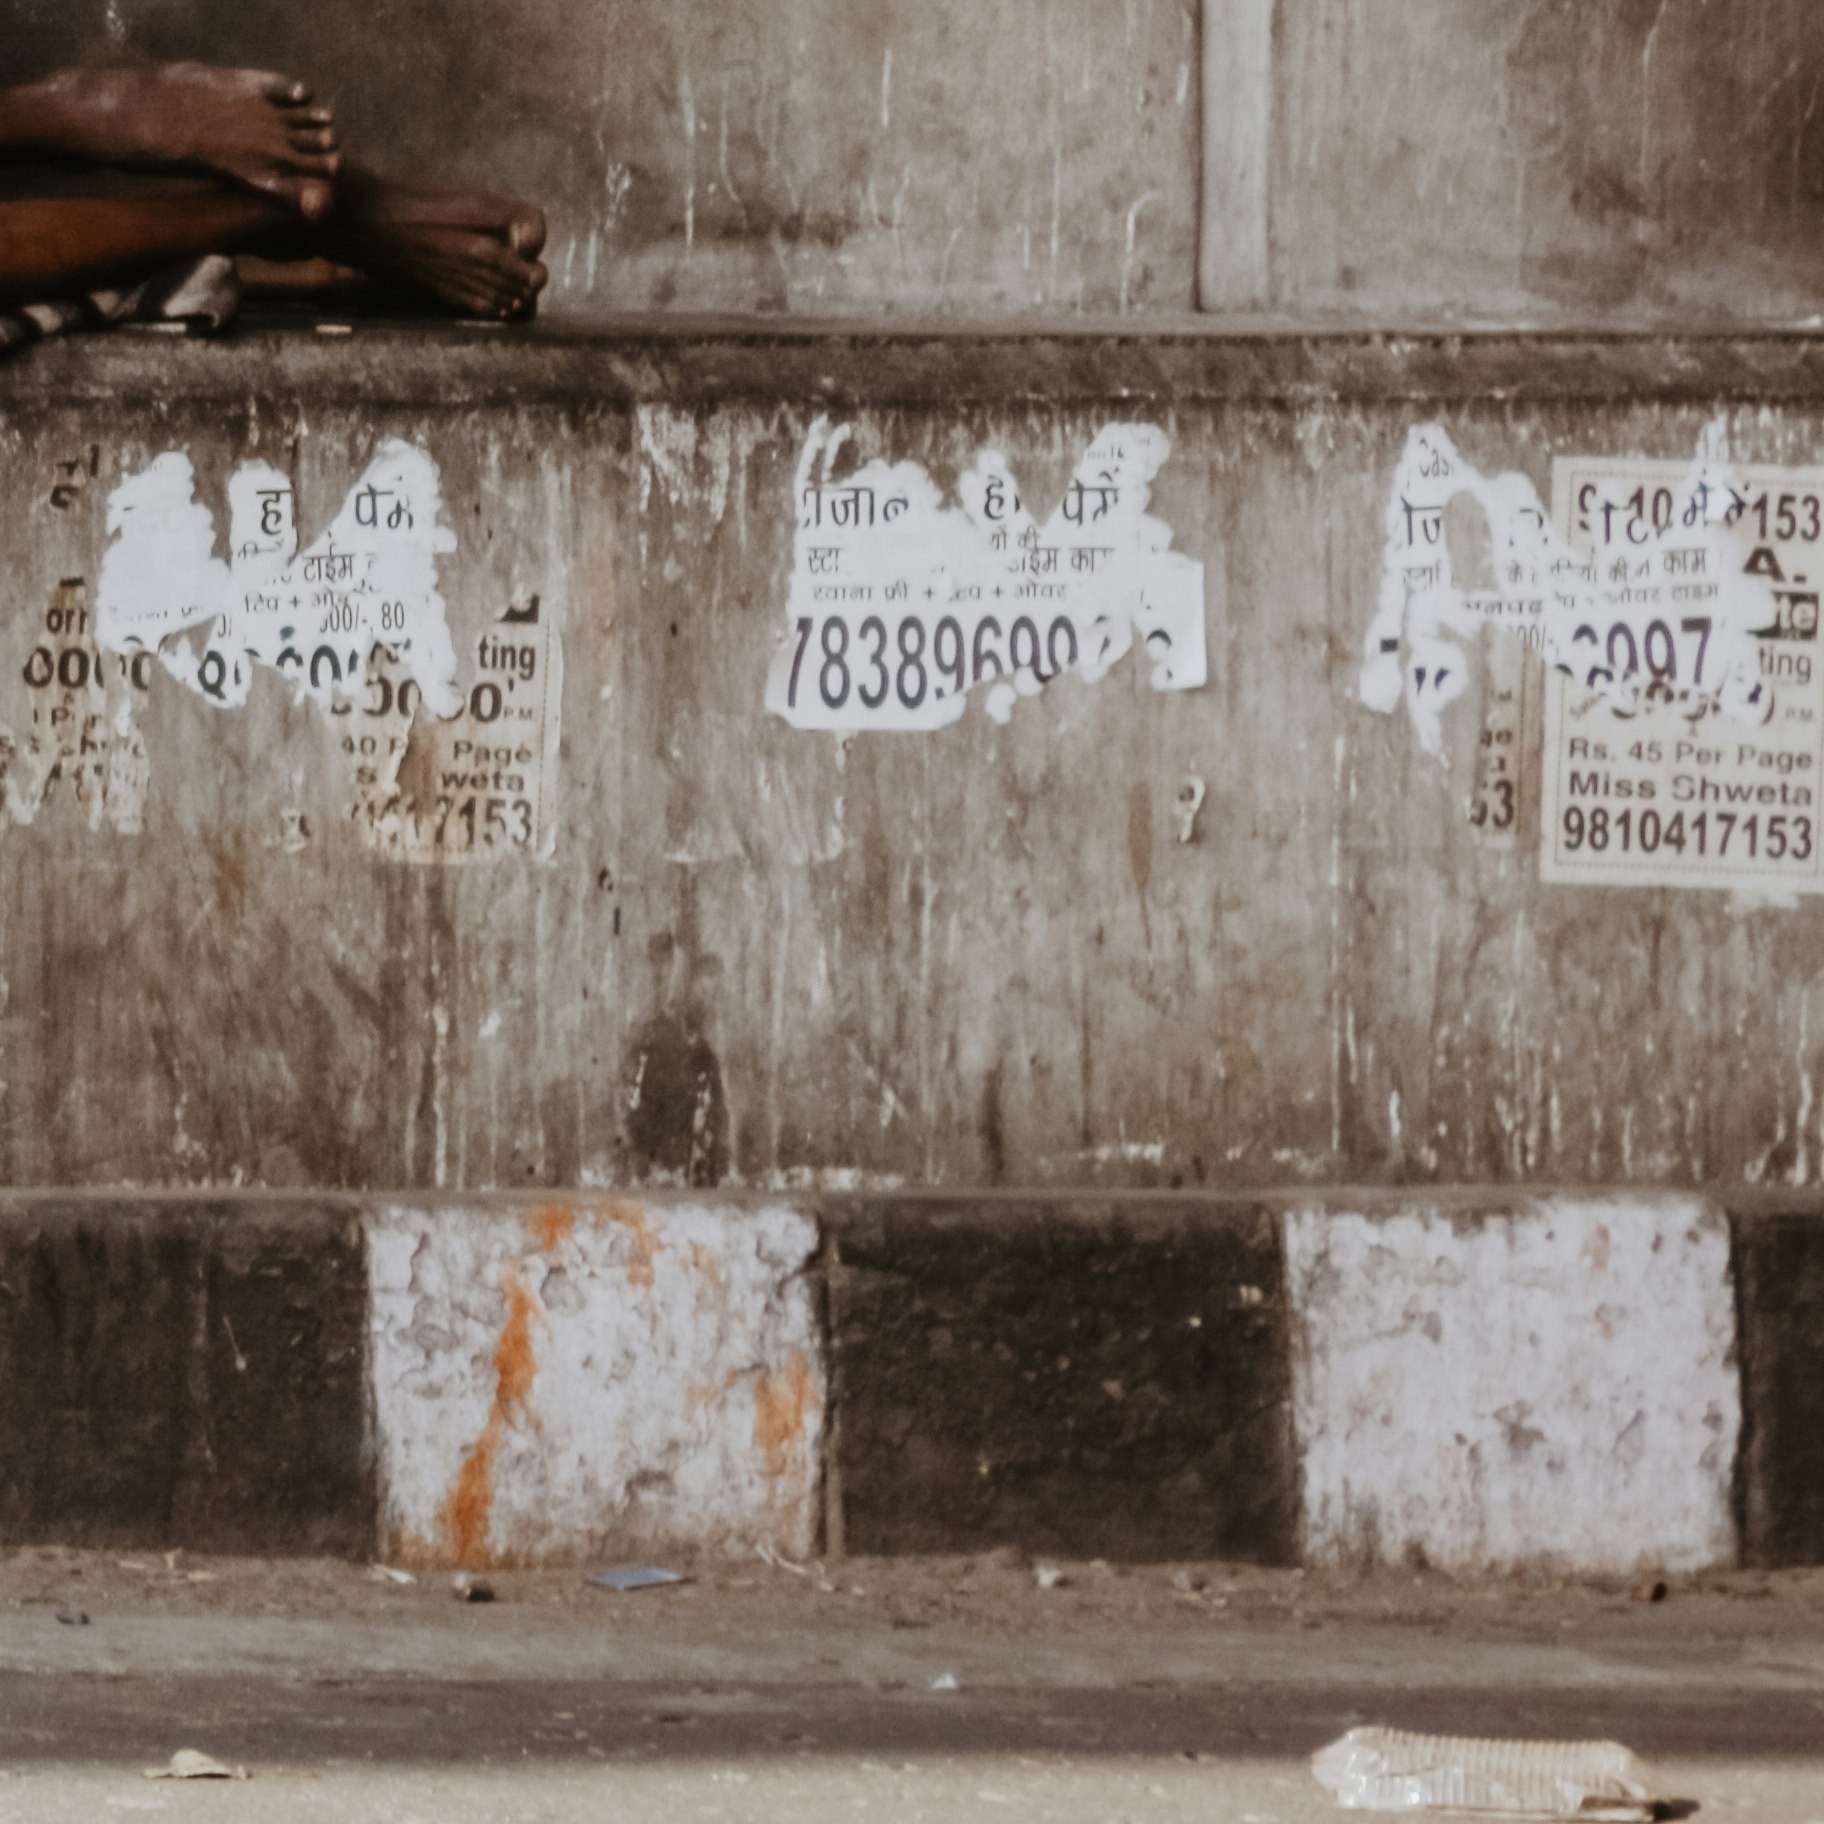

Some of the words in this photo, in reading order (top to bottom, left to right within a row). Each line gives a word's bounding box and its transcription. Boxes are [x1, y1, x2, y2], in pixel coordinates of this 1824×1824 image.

[1627, 740, 1663, 765] 45
[1674, 741, 1723, 767] Per
[1737, 744, 1814, 776] Page
[1568, 770, 1658, 800] Miss
[1671, 773, 1813, 807] Shweta
[1562, 805, 1815, 863] 9810417153
